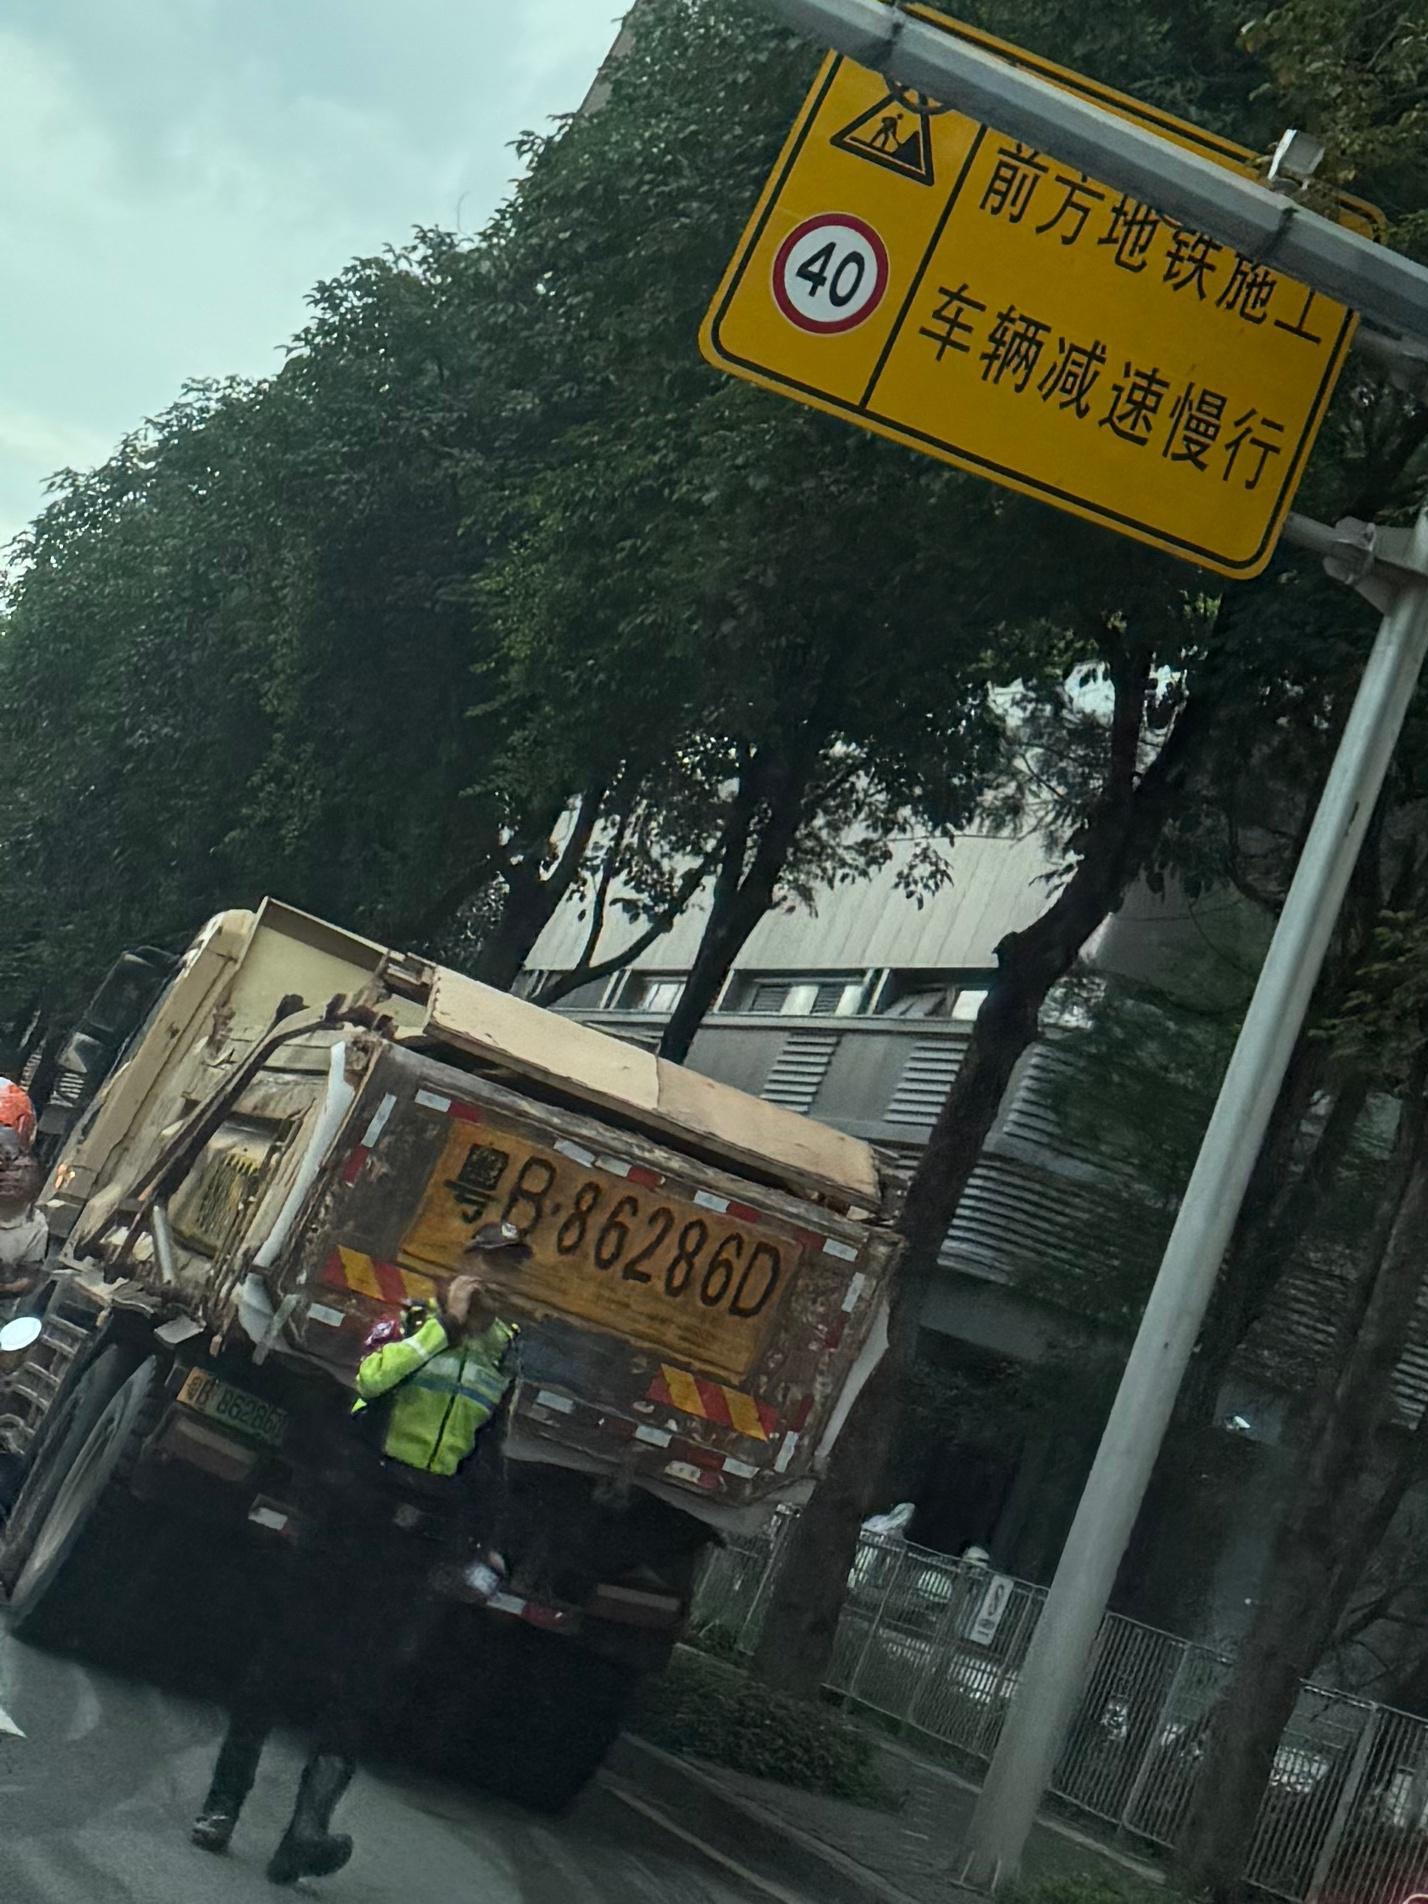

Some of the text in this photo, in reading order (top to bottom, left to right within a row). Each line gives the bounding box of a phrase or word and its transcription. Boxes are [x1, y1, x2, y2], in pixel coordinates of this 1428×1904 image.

[796, 241, 866, 307] 40
[979, 143, 1322, 345] 前方地铁施工
[918, 283, 1287, 491] 车辆减速慢行
